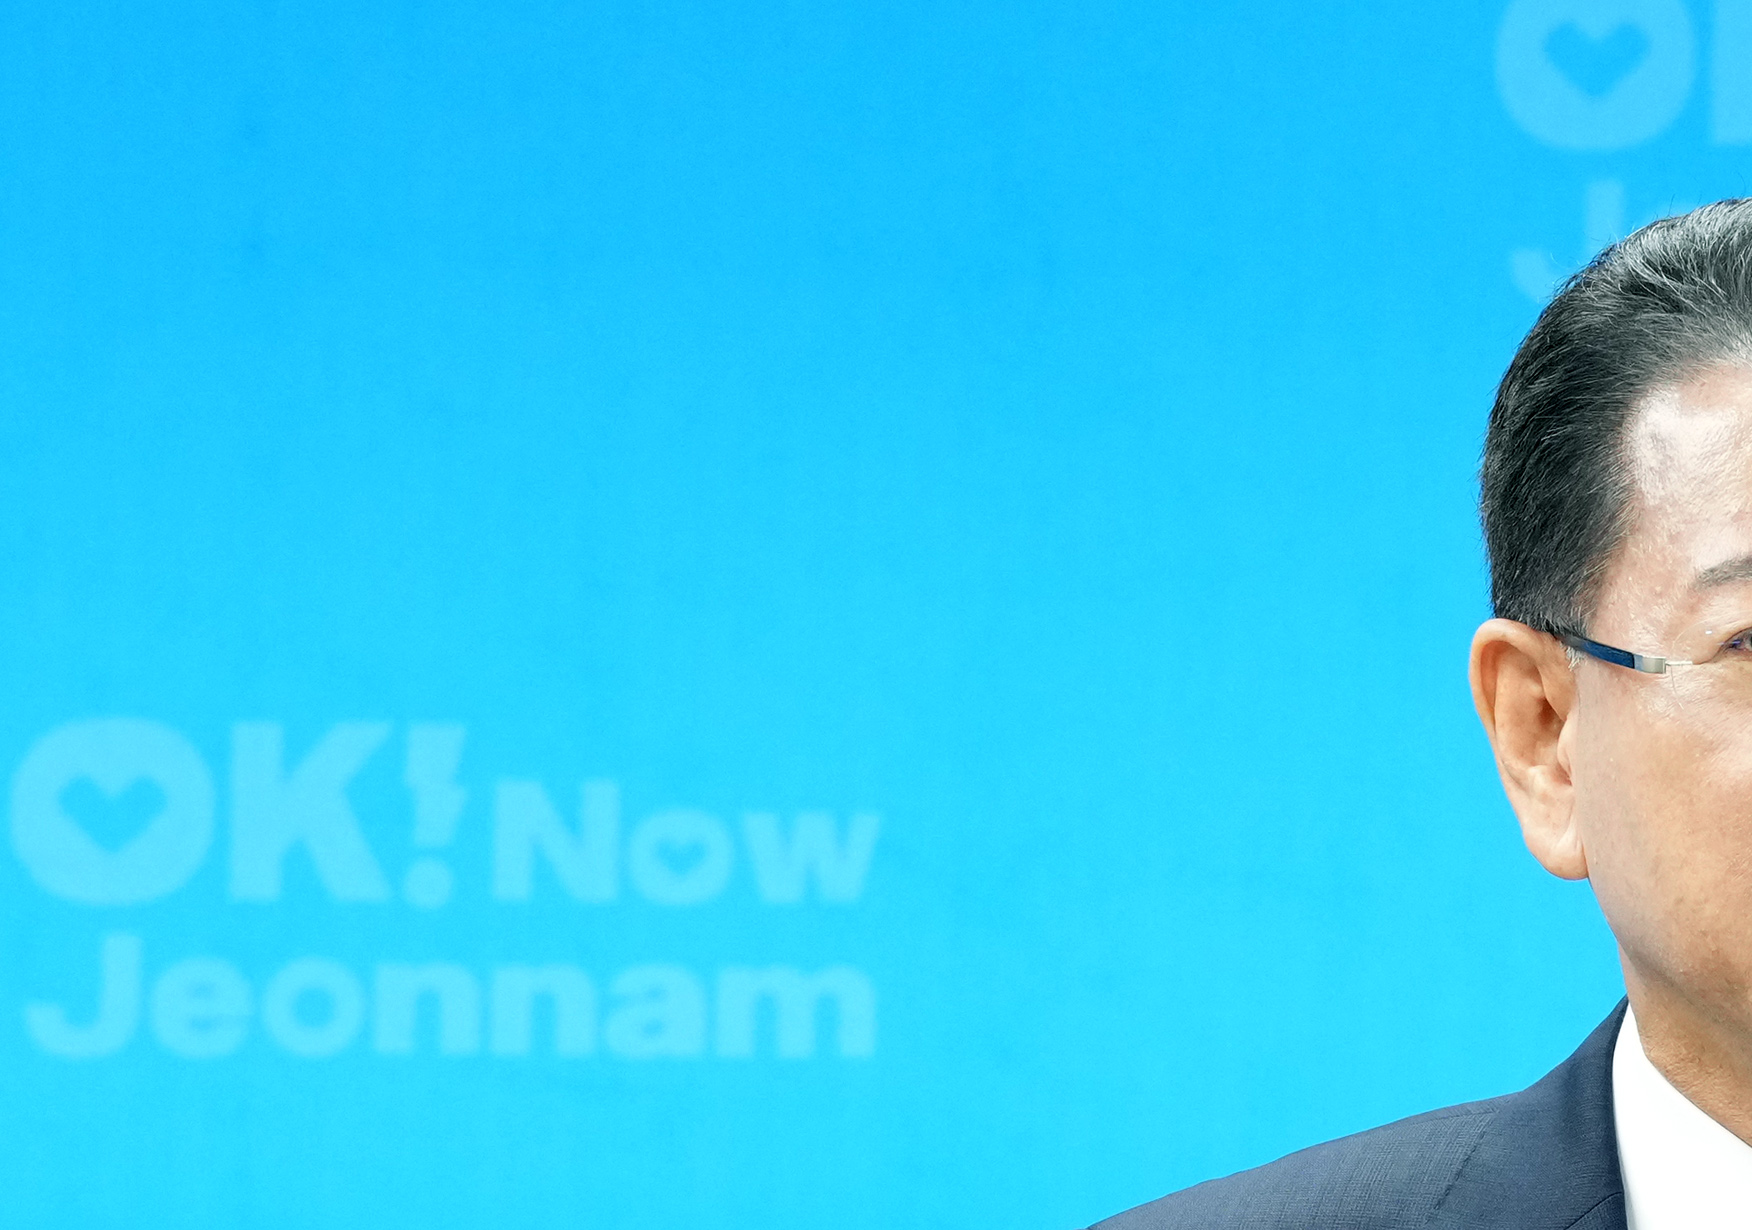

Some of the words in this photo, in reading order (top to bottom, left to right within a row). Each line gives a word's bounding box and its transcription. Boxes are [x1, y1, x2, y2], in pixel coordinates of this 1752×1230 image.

[9, 715, 469, 910] OK!
[491, 775, 882, 906] Now
[23, 932, 879, 1060] Jeonnam
